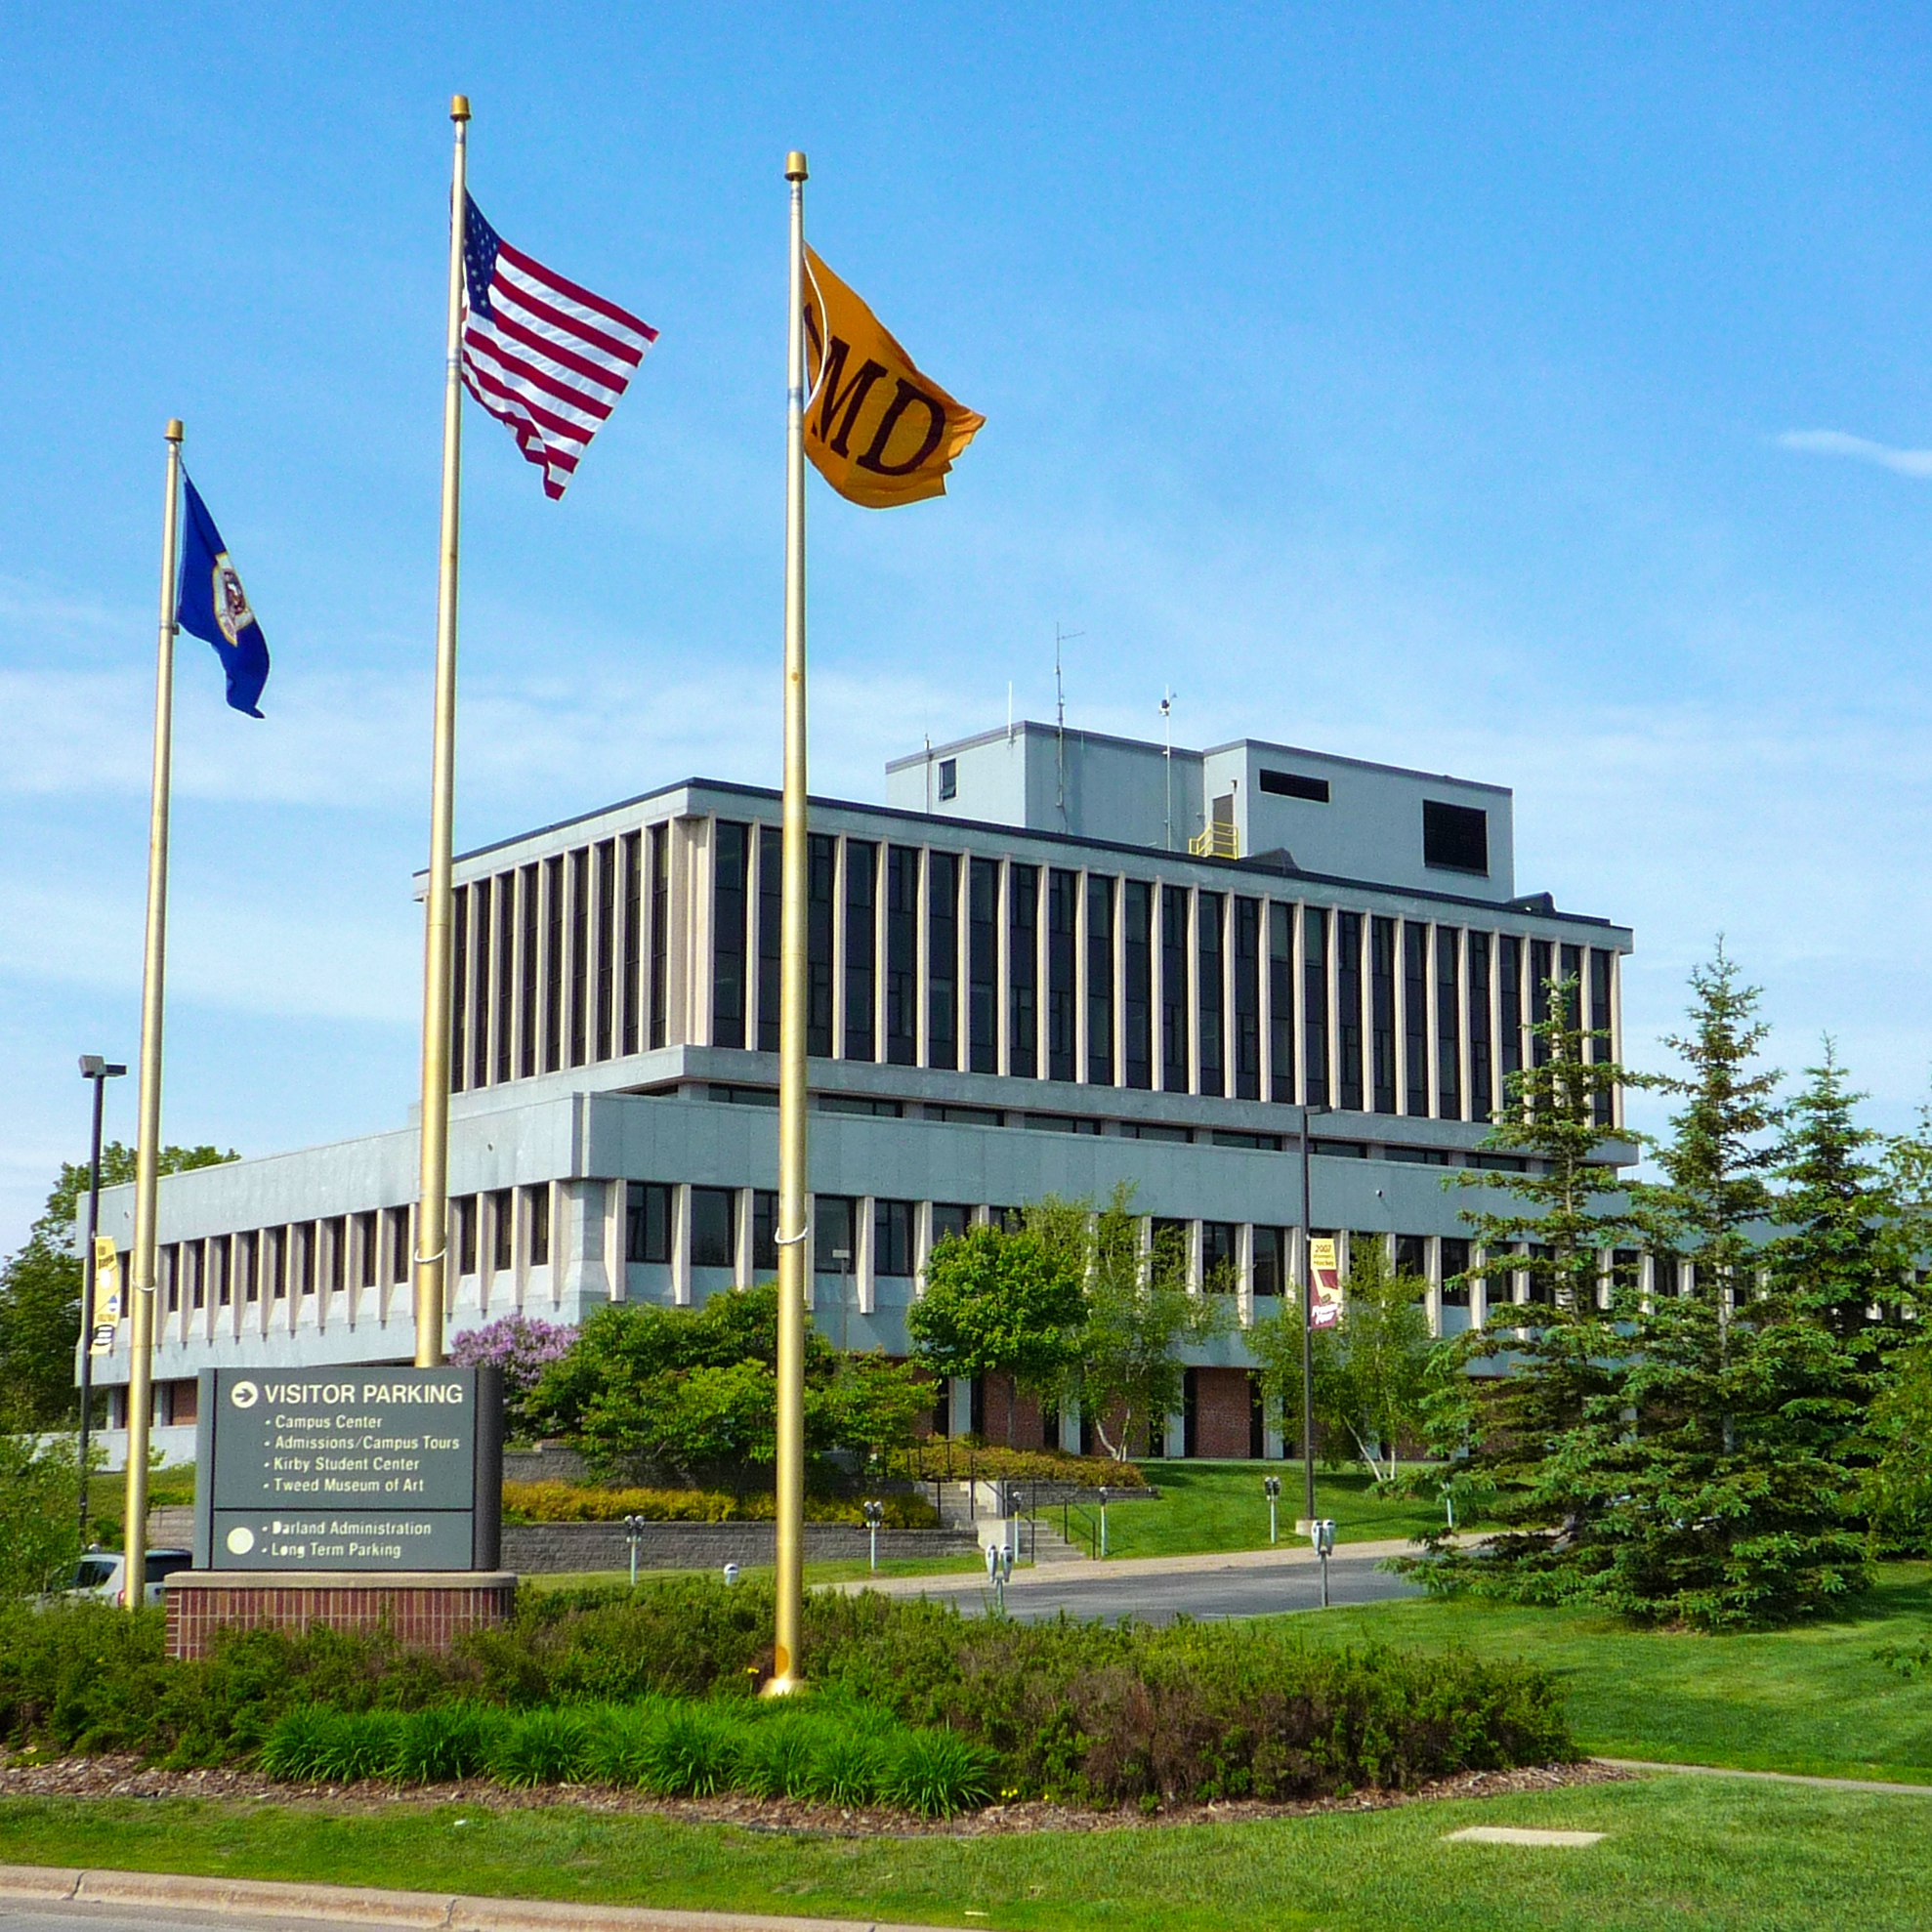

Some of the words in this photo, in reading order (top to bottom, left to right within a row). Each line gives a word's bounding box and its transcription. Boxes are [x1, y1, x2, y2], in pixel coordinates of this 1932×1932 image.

[265, 1384, 356, 1404] VISITOR
[363, 1383, 463, 1404] PARKING
[275, 1414, 332, 1431] Campus
[336, 1414, 383, 1429] Center
[275, 1436, 419, 1451] Admissions/Campus
[423, 1435, 460, 1449] Tours
[273, 1456, 311, 1473] Kirby
[315, 1456, 368, 1471] Student
[373, 1456, 420, 1471] Center
[273, 1478, 319, 1492] Tweed
[324, 1478, 380, 1492] Museum
[385, 1478, 399, 1492] of
[402, 1478, 424, 1492] Art
[273, 1521, 325, 1535] Darland
[330, 1521, 432, 1535] Administration
[272, 1542, 305, 1558] Long
[310, 1542, 344, 1557] Term
[349, 1542, 401, 1560] Parking
